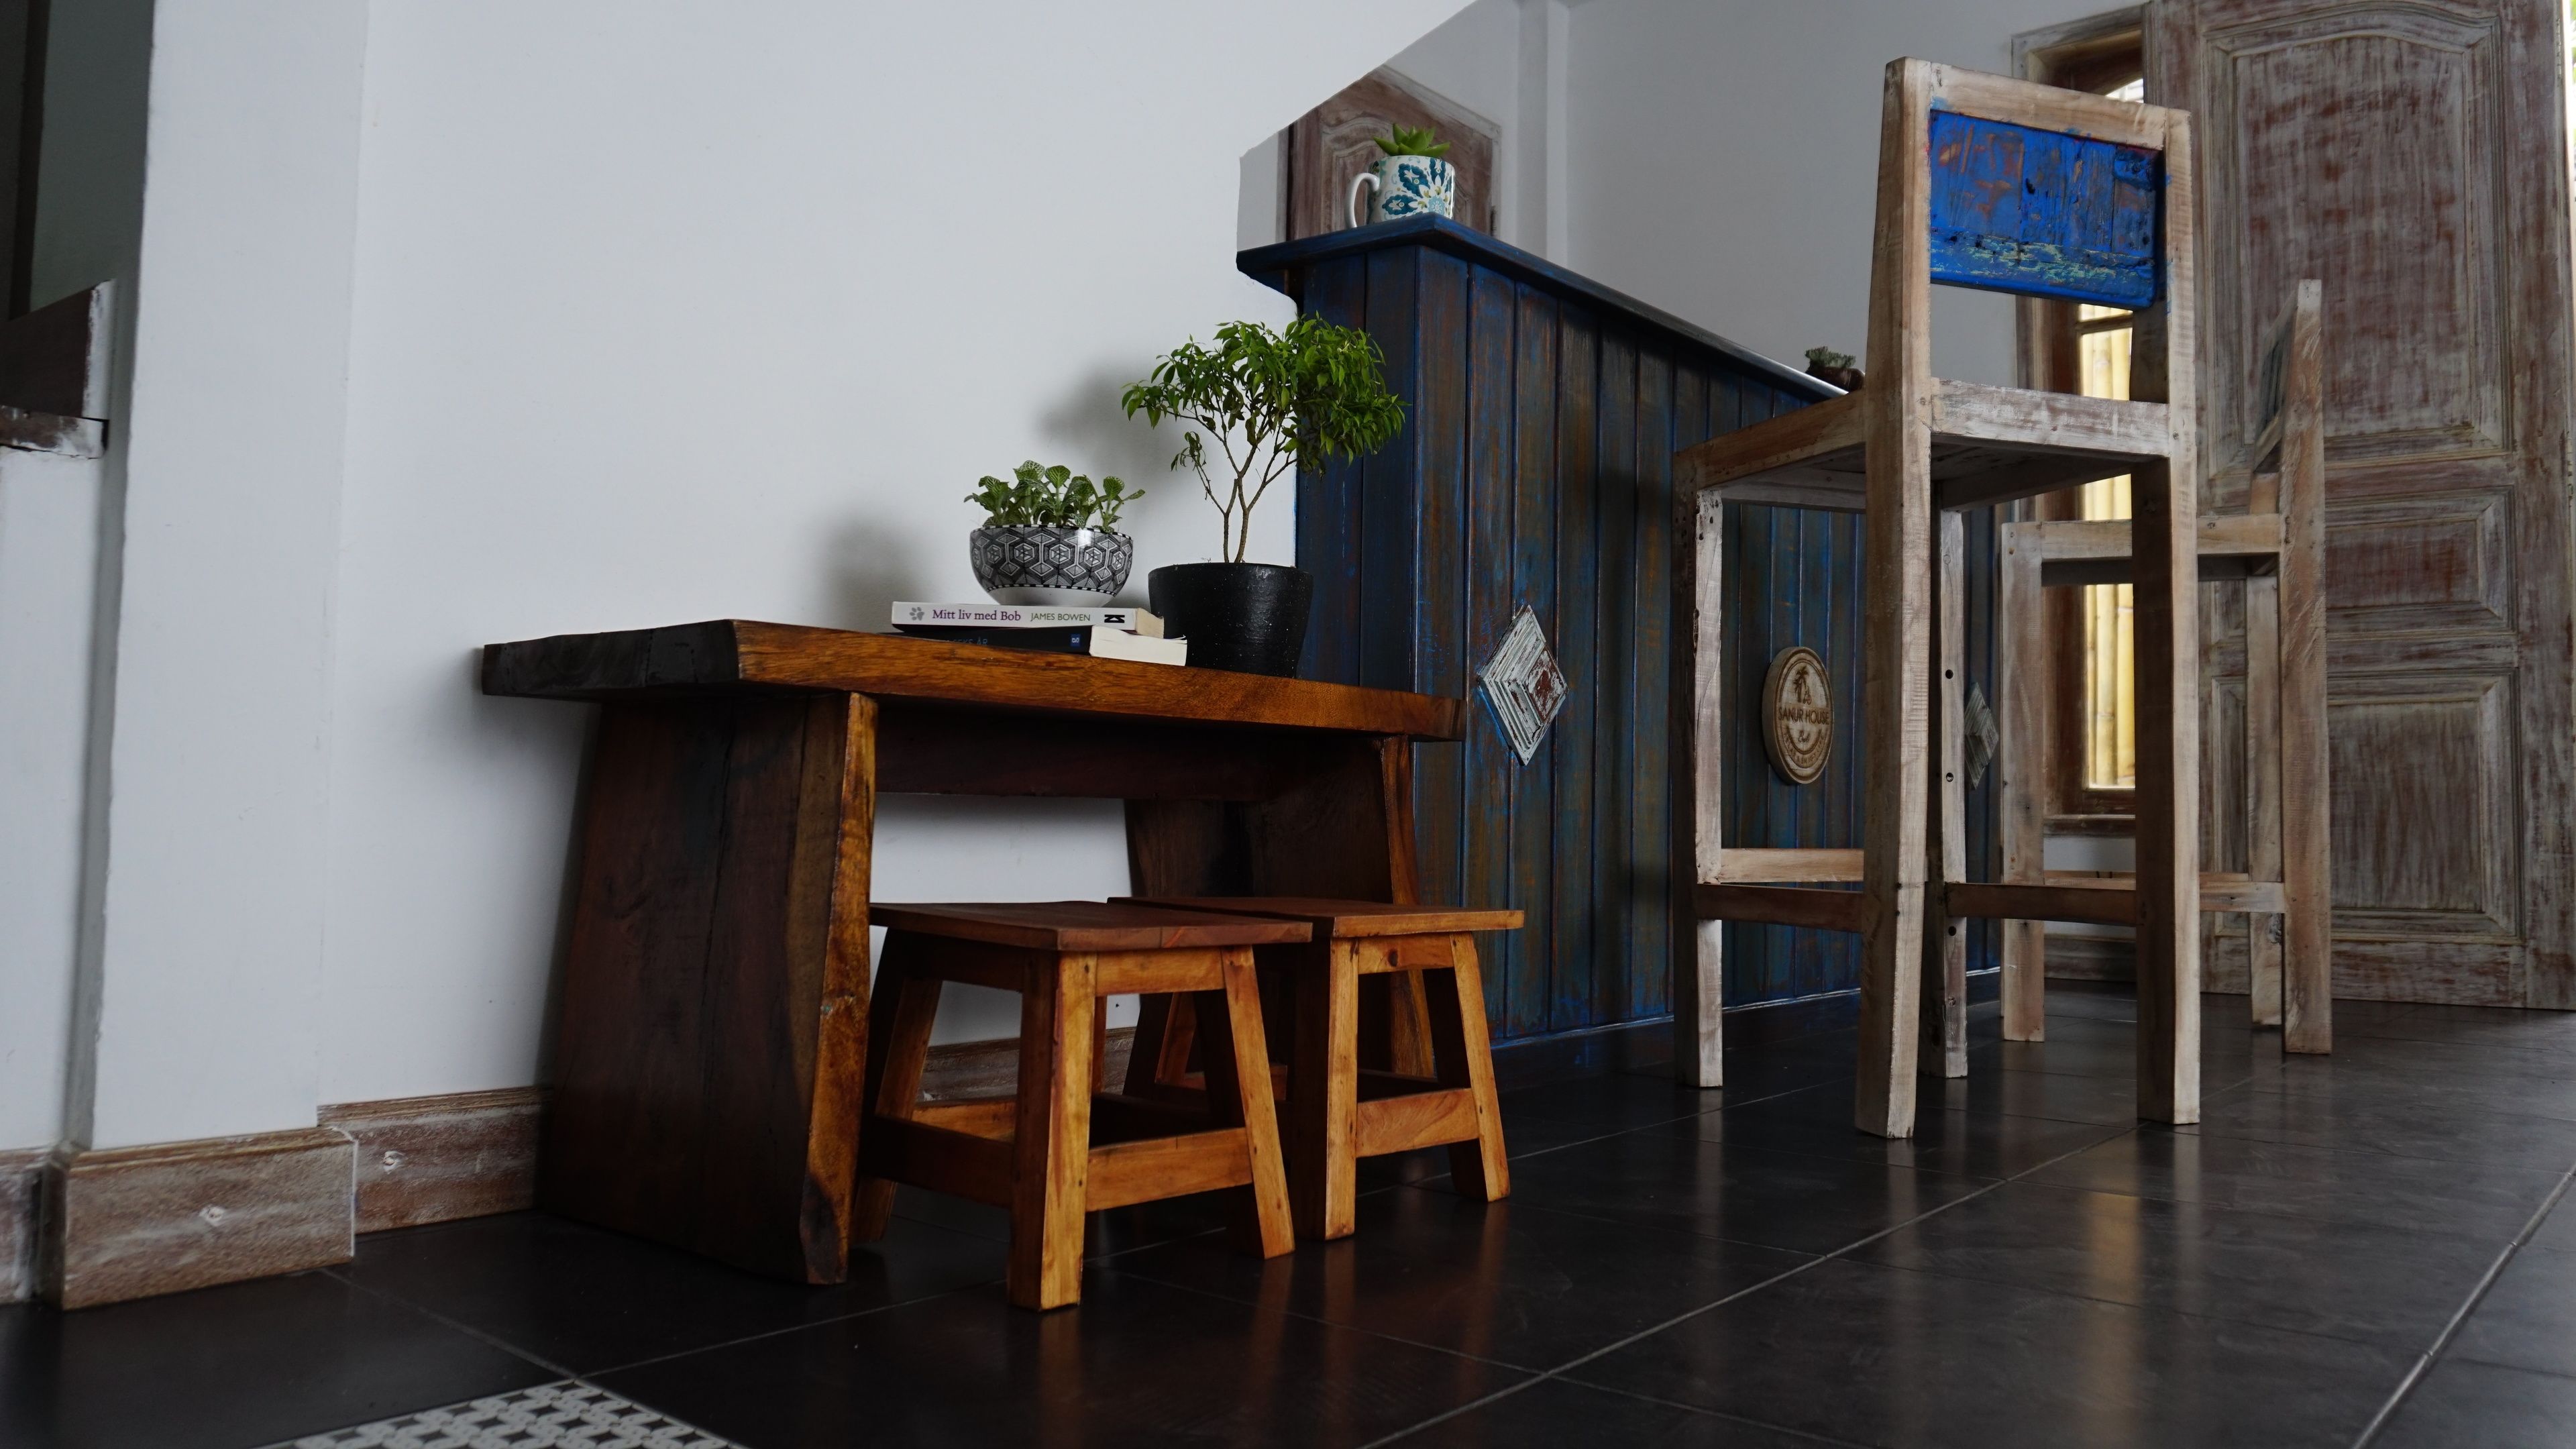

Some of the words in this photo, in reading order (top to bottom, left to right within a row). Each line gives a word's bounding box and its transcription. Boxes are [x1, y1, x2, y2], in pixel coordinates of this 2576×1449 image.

[932, 609, 956, 619] Mitt
[959, 609, 972, 620] liv
[974, 610, 997, 621] med
[1000, 610, 1022, 621] Bob
[1030, 613, 1056, 622] JAMES
[1057, 613, 1091, 622] BOWEN
[1778, 706, 1803, 722] SANUR
[1805, 709, 1830, 725] HOUSE
